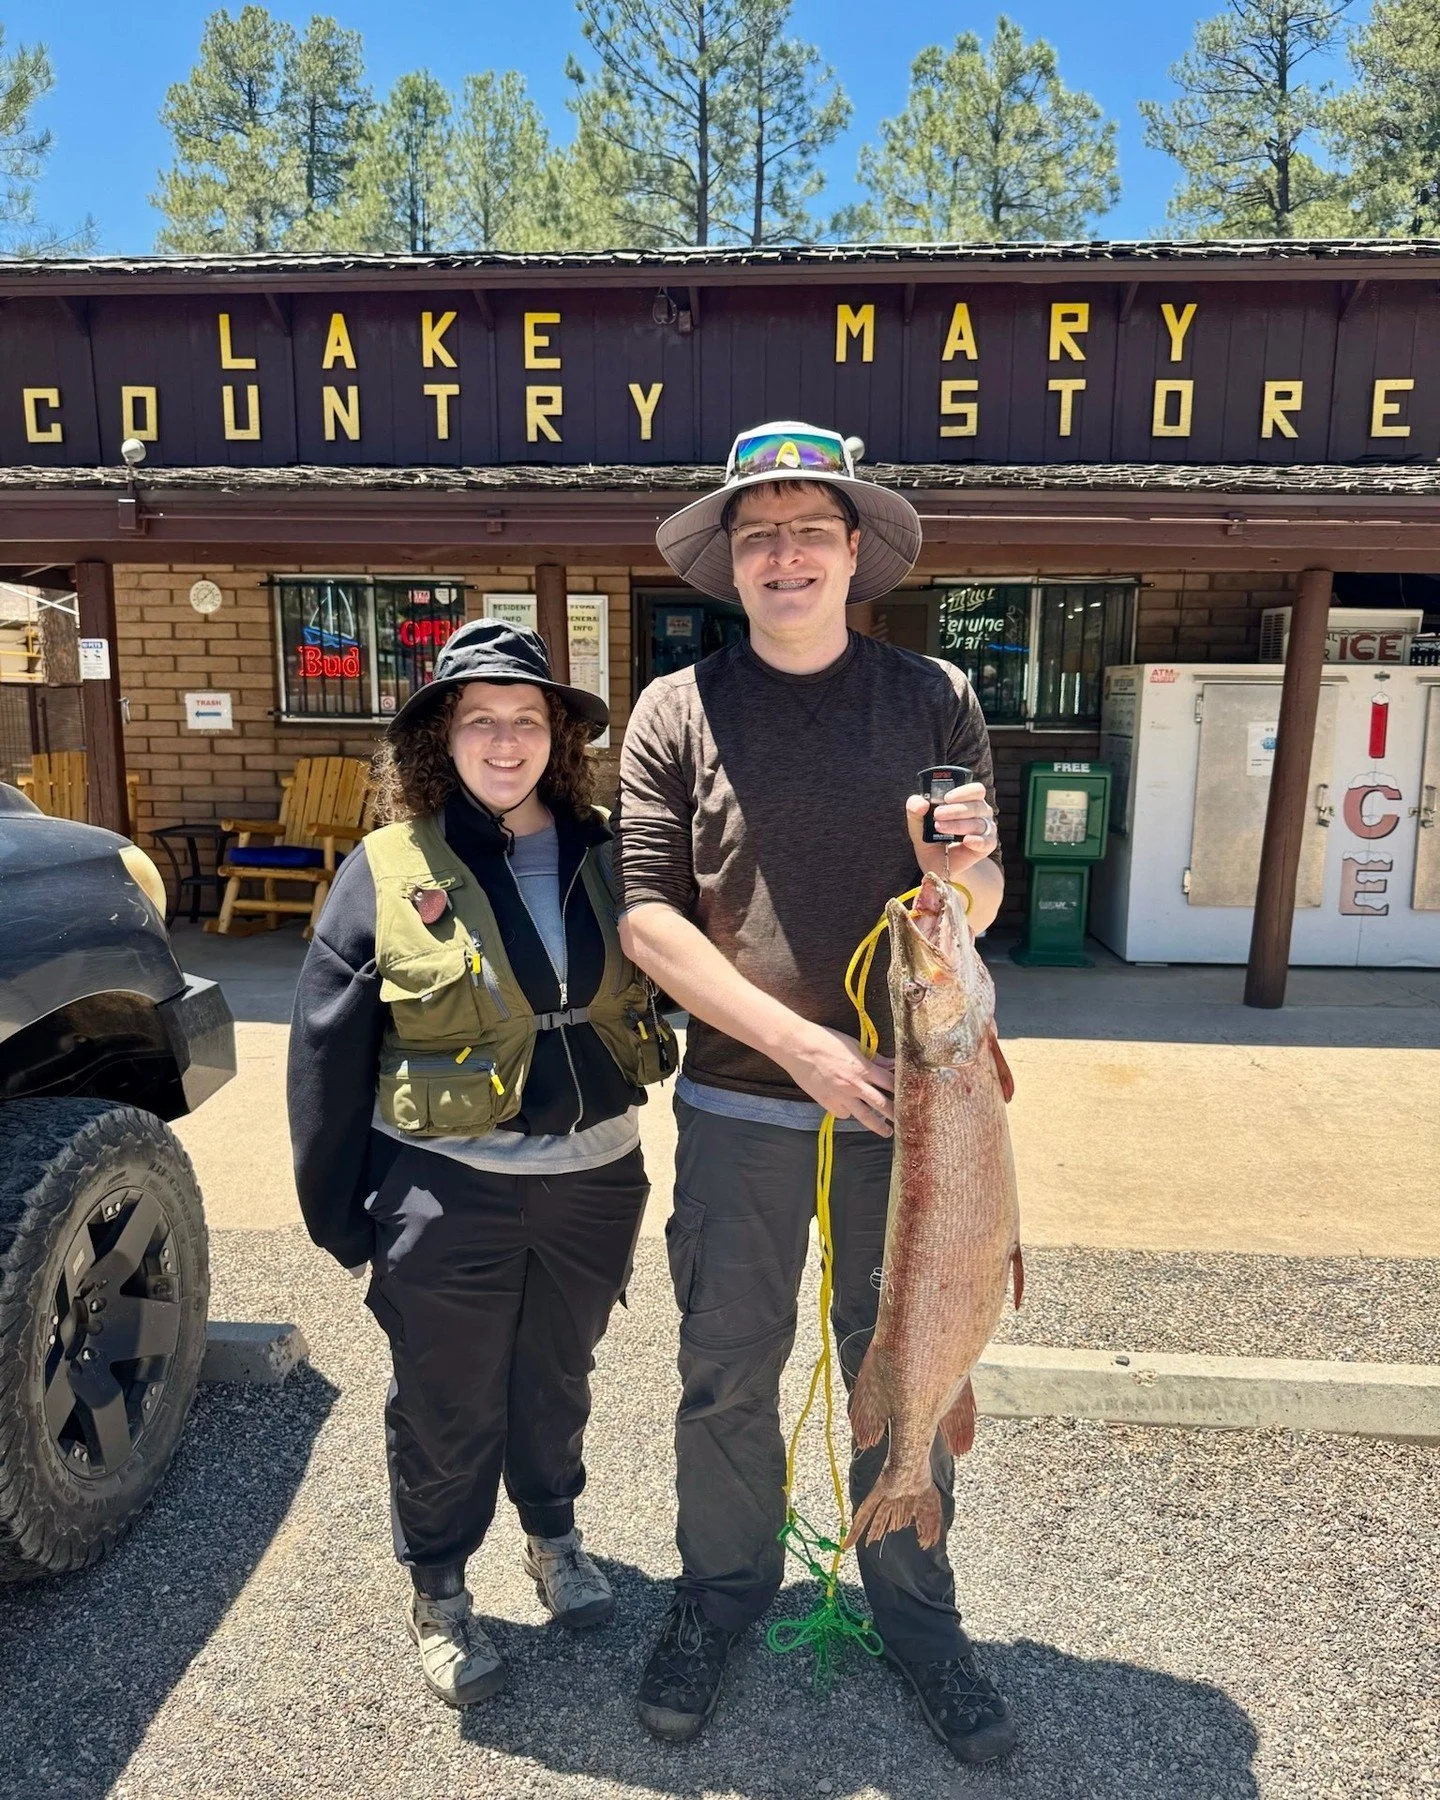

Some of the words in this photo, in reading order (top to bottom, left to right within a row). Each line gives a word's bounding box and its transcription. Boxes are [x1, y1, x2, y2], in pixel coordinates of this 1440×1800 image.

[219, 312, 562, 370] LAKE
[835, 302, 1198, 363] MARY
[23, 384, 663, 443] COUNTRY
[940, 378, 1414, 438] STORE
[492, 603, 531, 611] RESIDENT
[400, 619, 463, 647] OPE
[1338, 632, 1404, 661] ICE
[297, 645, 363, 678] Bud
[1152, 668, 1175, 676] ATM
[1053, 762, 1091, 773] FREE
[1338, 691, 1403, 916] ICE
